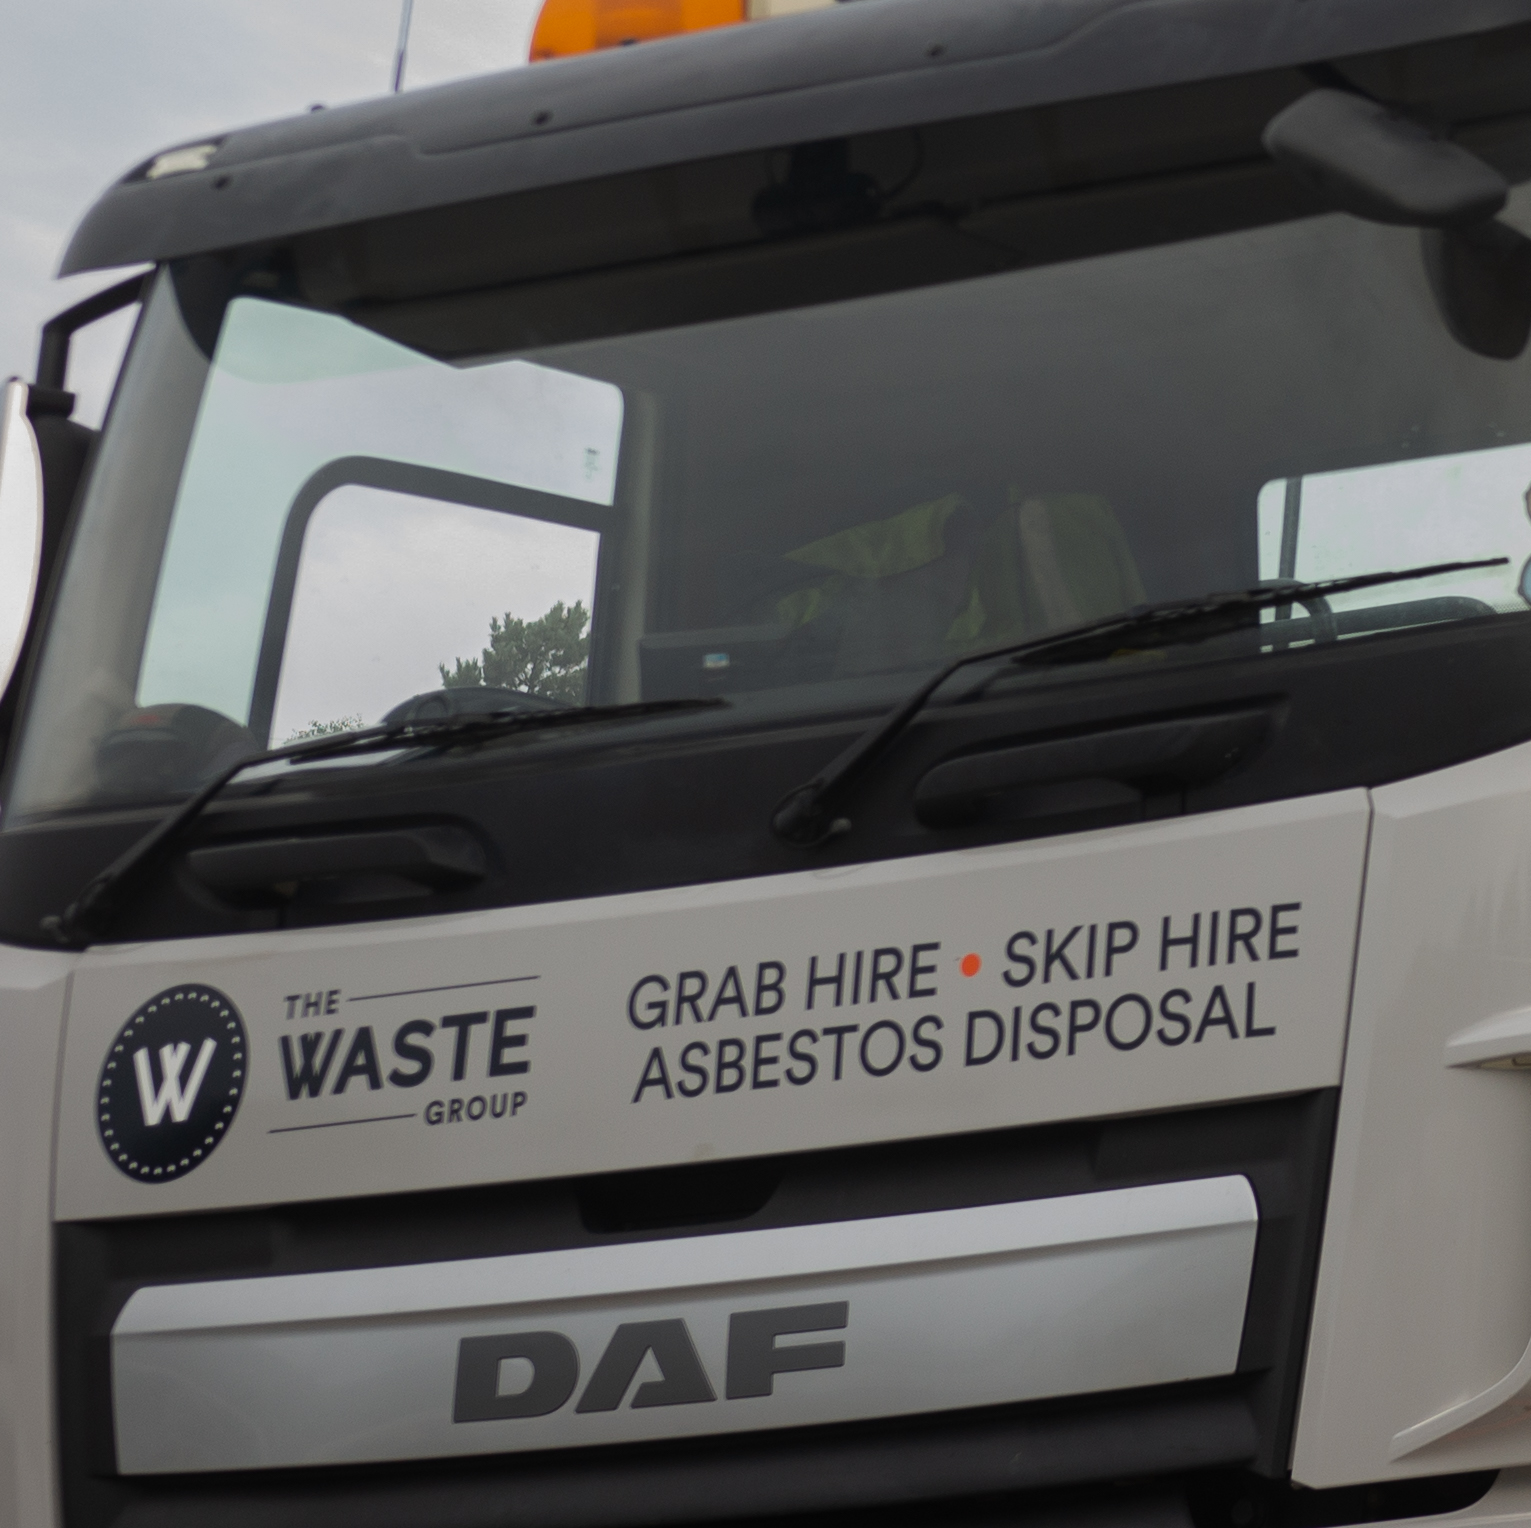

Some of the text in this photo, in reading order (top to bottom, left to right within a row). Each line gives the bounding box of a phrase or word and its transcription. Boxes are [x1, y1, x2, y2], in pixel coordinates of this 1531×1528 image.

[283, 989, 342, 1020] THE
[627, 902, 1303, 1031] GRAB HIRE SKIP HIRE
[133, 1036, 217, 1127] W
[280, 1006, 538, 1101] WASTE
[631, 981, 1277, 1104] ASBESTOS DISPOSAL
[424, 1091, 528, 1126] GROUP
[451, 1300, 850, 1424] DAF
